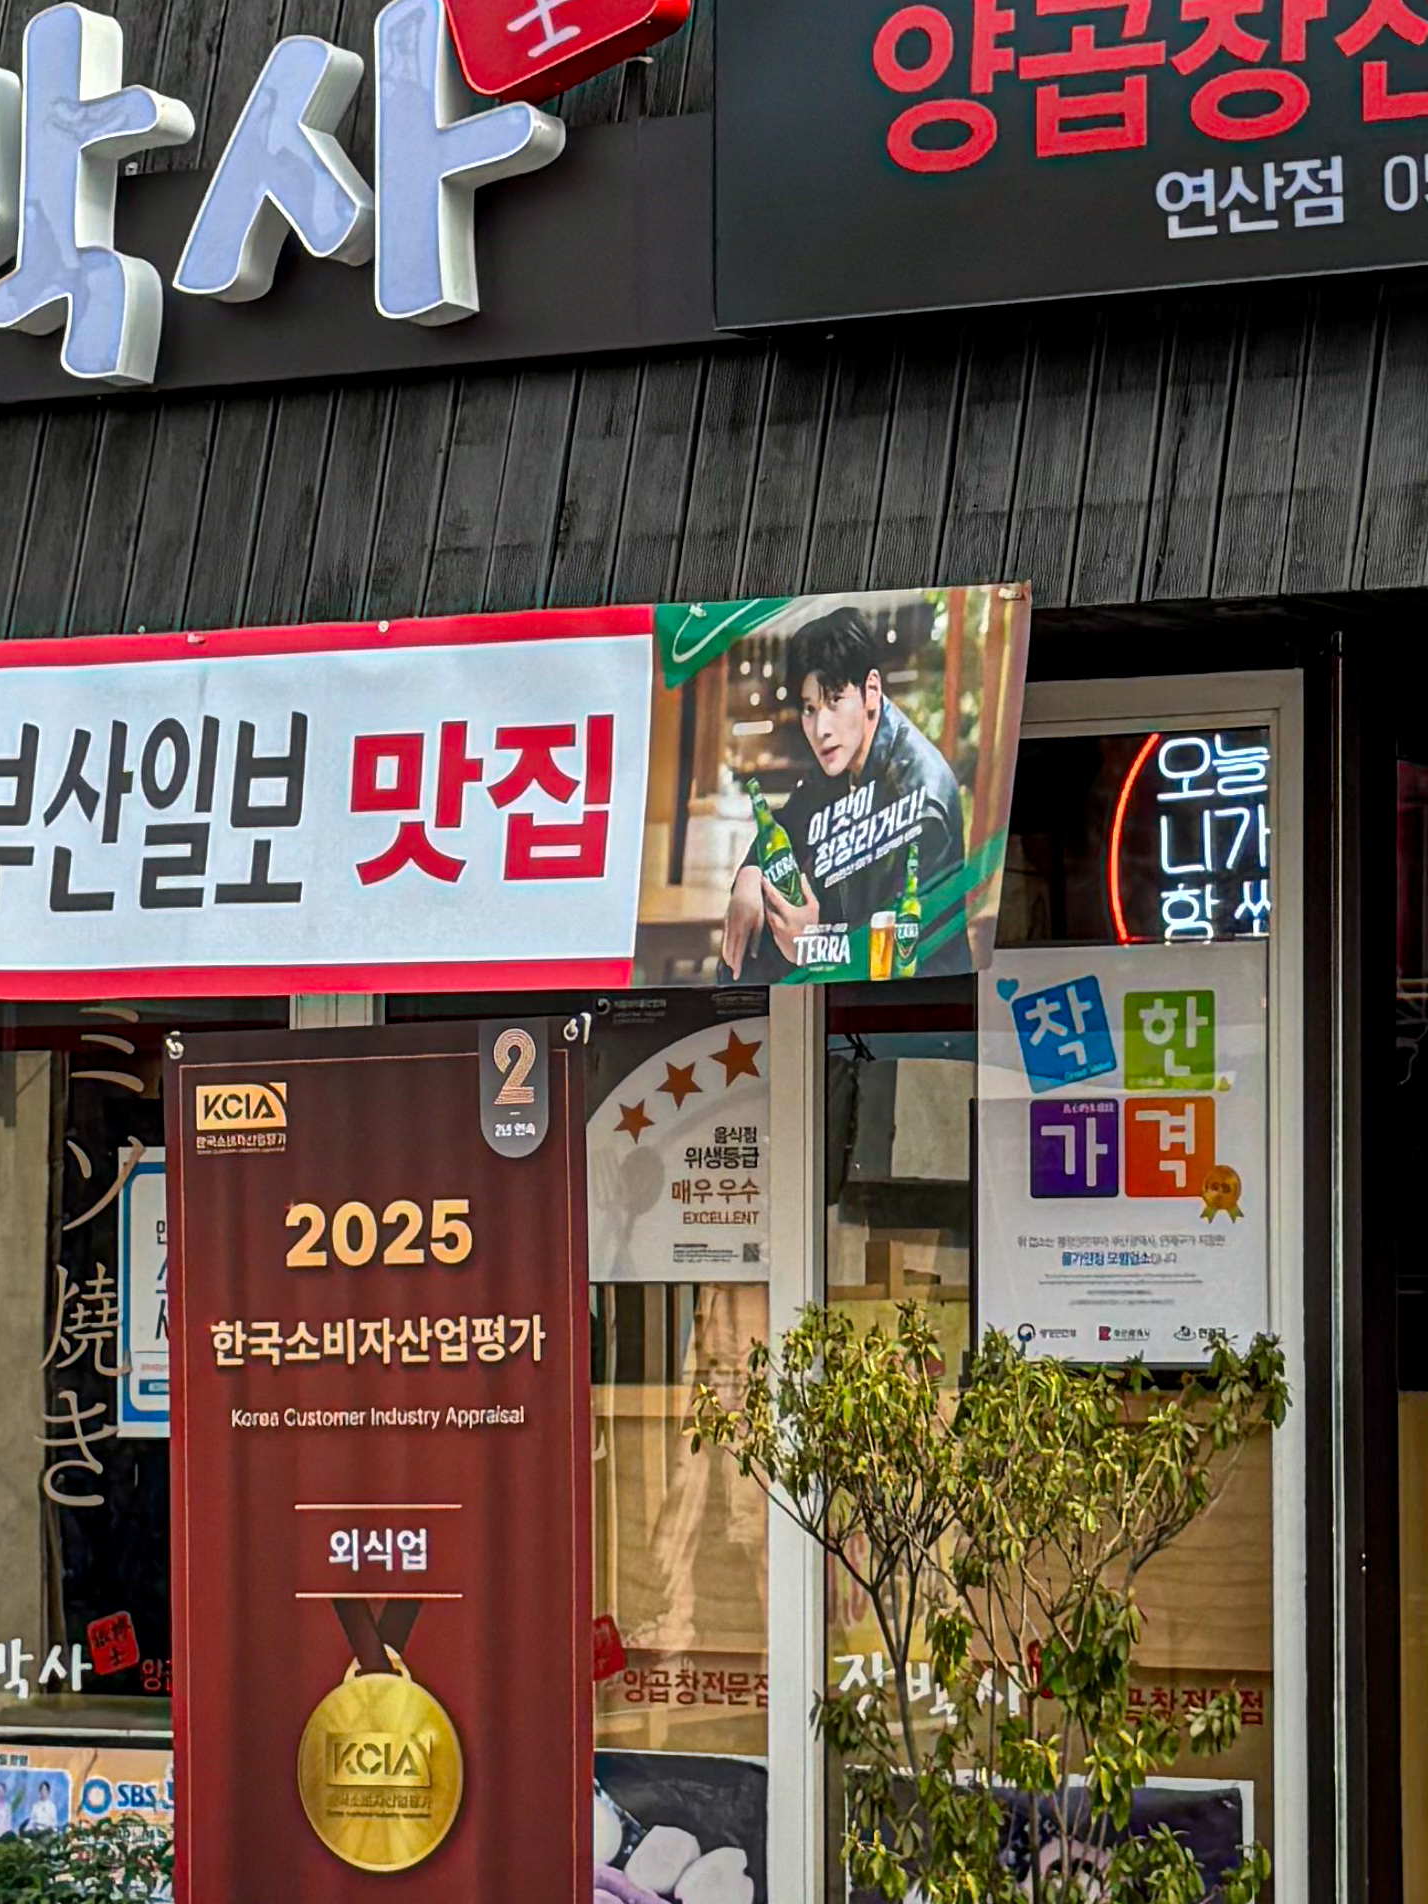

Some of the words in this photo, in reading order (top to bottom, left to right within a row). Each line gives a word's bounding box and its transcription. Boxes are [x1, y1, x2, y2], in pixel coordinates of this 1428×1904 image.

[1155, 156, 1344, 239] 연산점
[1157, 733, 1270, 801] 오늘
[349, 715, 612, 885] 맛집
[793, 934, 851, 966] TERRA
[204, 1094, 275, 1120] KCIA
[285, 1200, 472, 1267] 2025
[683, 1211, 759, 1225] EXCELLENT
[211, 1315, 546, 1367] 한국소비자산업평가
[232, 1409, 279, 1427] Korea
[284, 1408, 365, 1427] Customer
[371, 1407, 440, 1431] Industry
[445, 1405, 524, 1430] Appraisal
[328, 1528, 428, 1571] 외식업
[334, 1742, 420, 1776] KCIA
